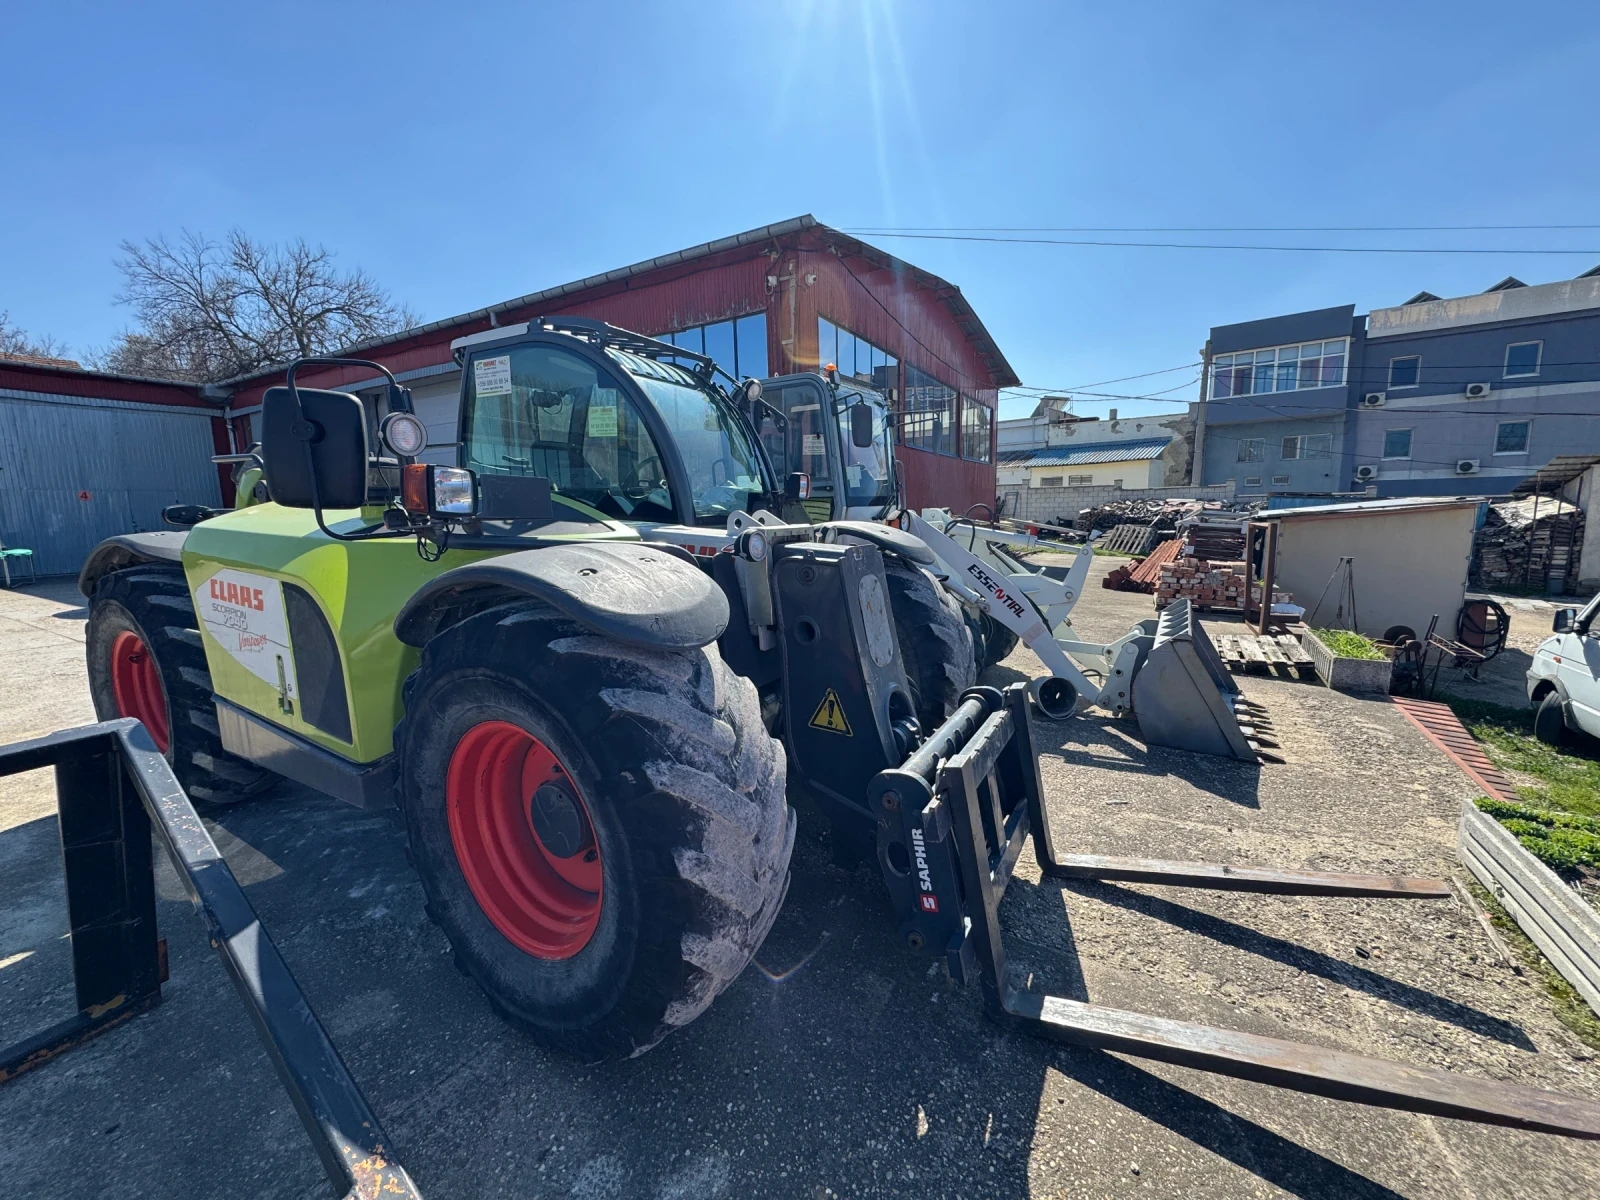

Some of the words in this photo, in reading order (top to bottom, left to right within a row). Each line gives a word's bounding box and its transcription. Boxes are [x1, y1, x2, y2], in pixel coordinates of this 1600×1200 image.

[210, 579, 264, 612] CLAAS
[212, 602, 247, 620] SCORPION
[967, 563, 1026, 619] ESSENTIAL
[911, 828, 932, 891] SAPHIR
